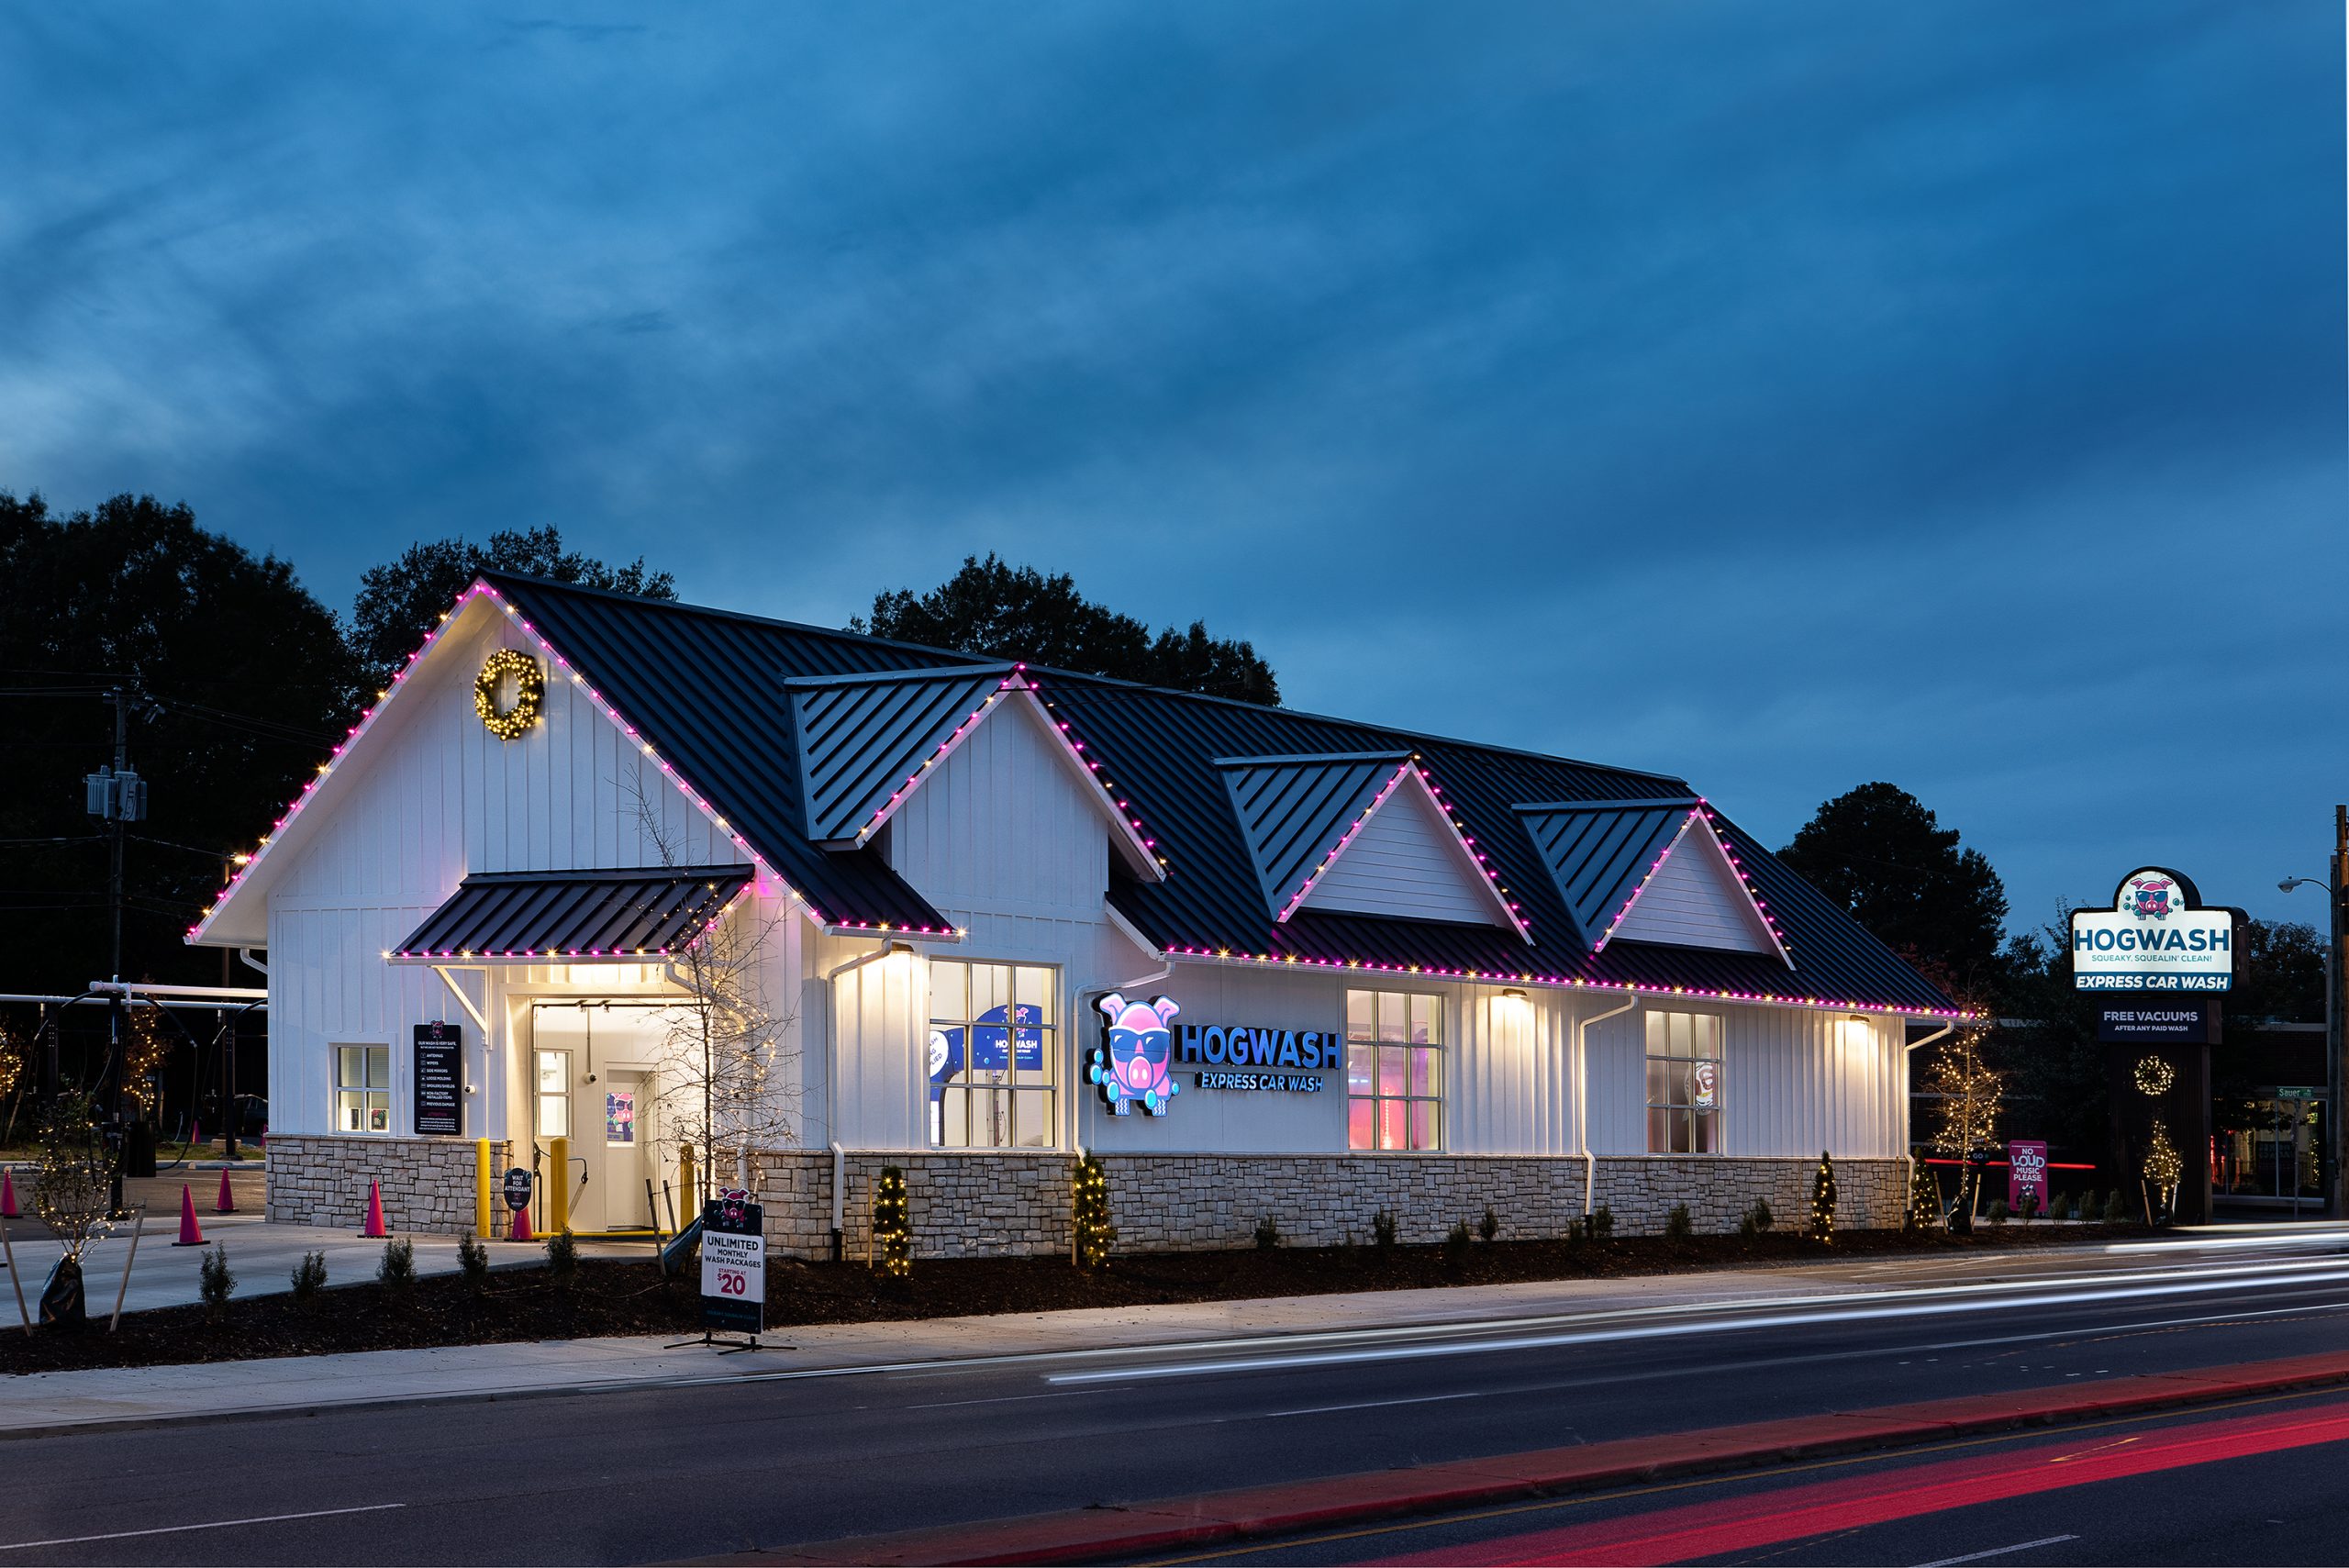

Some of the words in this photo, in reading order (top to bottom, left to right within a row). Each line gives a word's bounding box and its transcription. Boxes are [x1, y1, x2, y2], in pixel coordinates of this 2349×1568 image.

[2074, 929, 2230, 951] HOGWASH
[2076, 975, 2143, 988] EXPRESS
[2145, 975, 2178, 989] CAR
[2181, 976, 2229, 990] WASH
[2104, 1011, 2135, 1021] FREE
[2136, 1011, 2199, 1022] VACUUMS
[1181, 1024, 1342, 1070] HOGWASH
[1201, 1072, 1257, 1089] EXPRESS
[1259, 1075, 1285, 1090] CAR
[1287, 1076, 1324, 1092] WASH
[2278, 1088, 2299, 1096] Sauer
[2011, 1154, 2045, 1168] LOUD
[707, 1236, 759, 1251] UNLIMITED
[718, 1249, 748, 1258] MONTHLY
[705, 1255, 725, 1264] WASH
[726, 1258, 762, 1268] PACKAGES
[717, 1273, 746, 1296] $20
